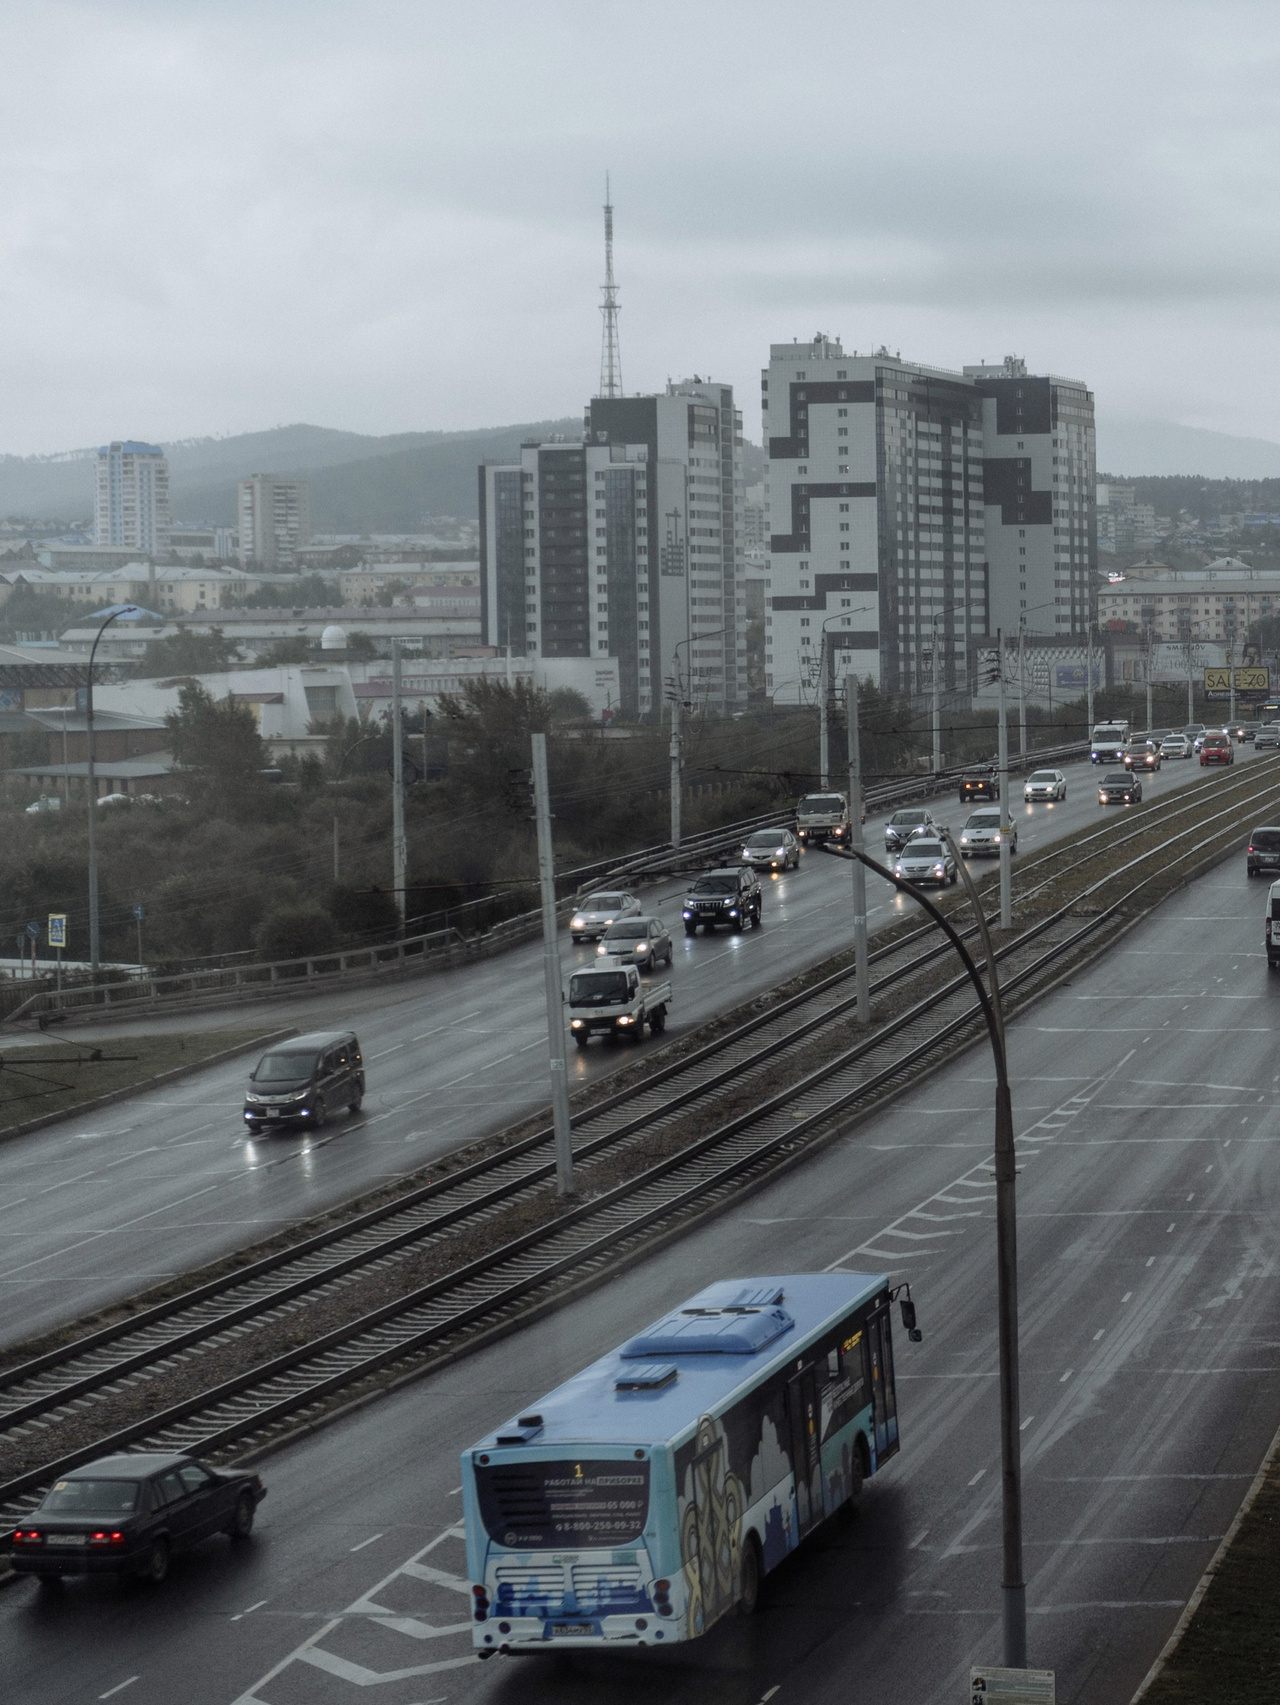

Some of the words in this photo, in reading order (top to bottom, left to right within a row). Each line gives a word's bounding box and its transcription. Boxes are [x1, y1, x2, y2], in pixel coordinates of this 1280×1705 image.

[574, 1464, 584, 1478] 1
[544, 1477, 583, 1487] РАБОТАЙ
[585, 1477, 597, 1486] НА
[598, 1476, 642, 1485] ПРИБОРКЕ
[607, 1501, 618, 1510] 65
[619, 1500, 636, 1509] 000
[563, 1520, 642, 1531] 8-800-250-09-32
